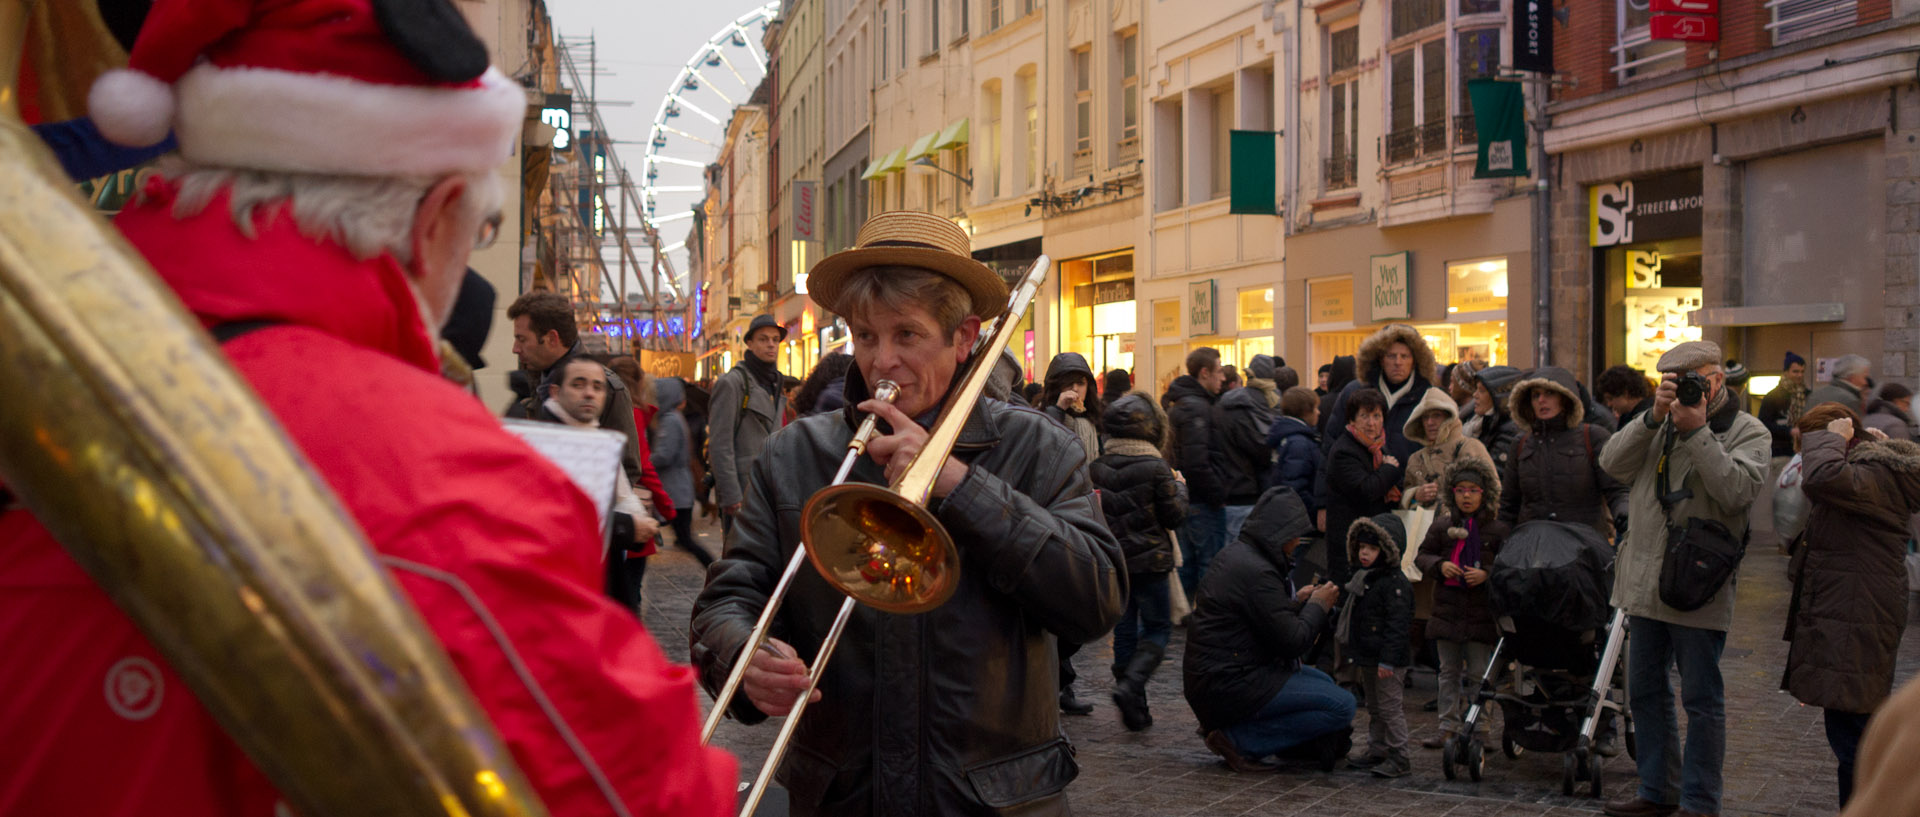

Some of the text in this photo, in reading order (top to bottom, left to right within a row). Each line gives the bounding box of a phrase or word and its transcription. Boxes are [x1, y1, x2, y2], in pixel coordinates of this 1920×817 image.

[795, 186, 811, 236] Etam
[1379, 264, 1398, 287] Yves
[1375, 284, 1404, 309] Rocher
[1191, 306, 1210, 327] Rocher
